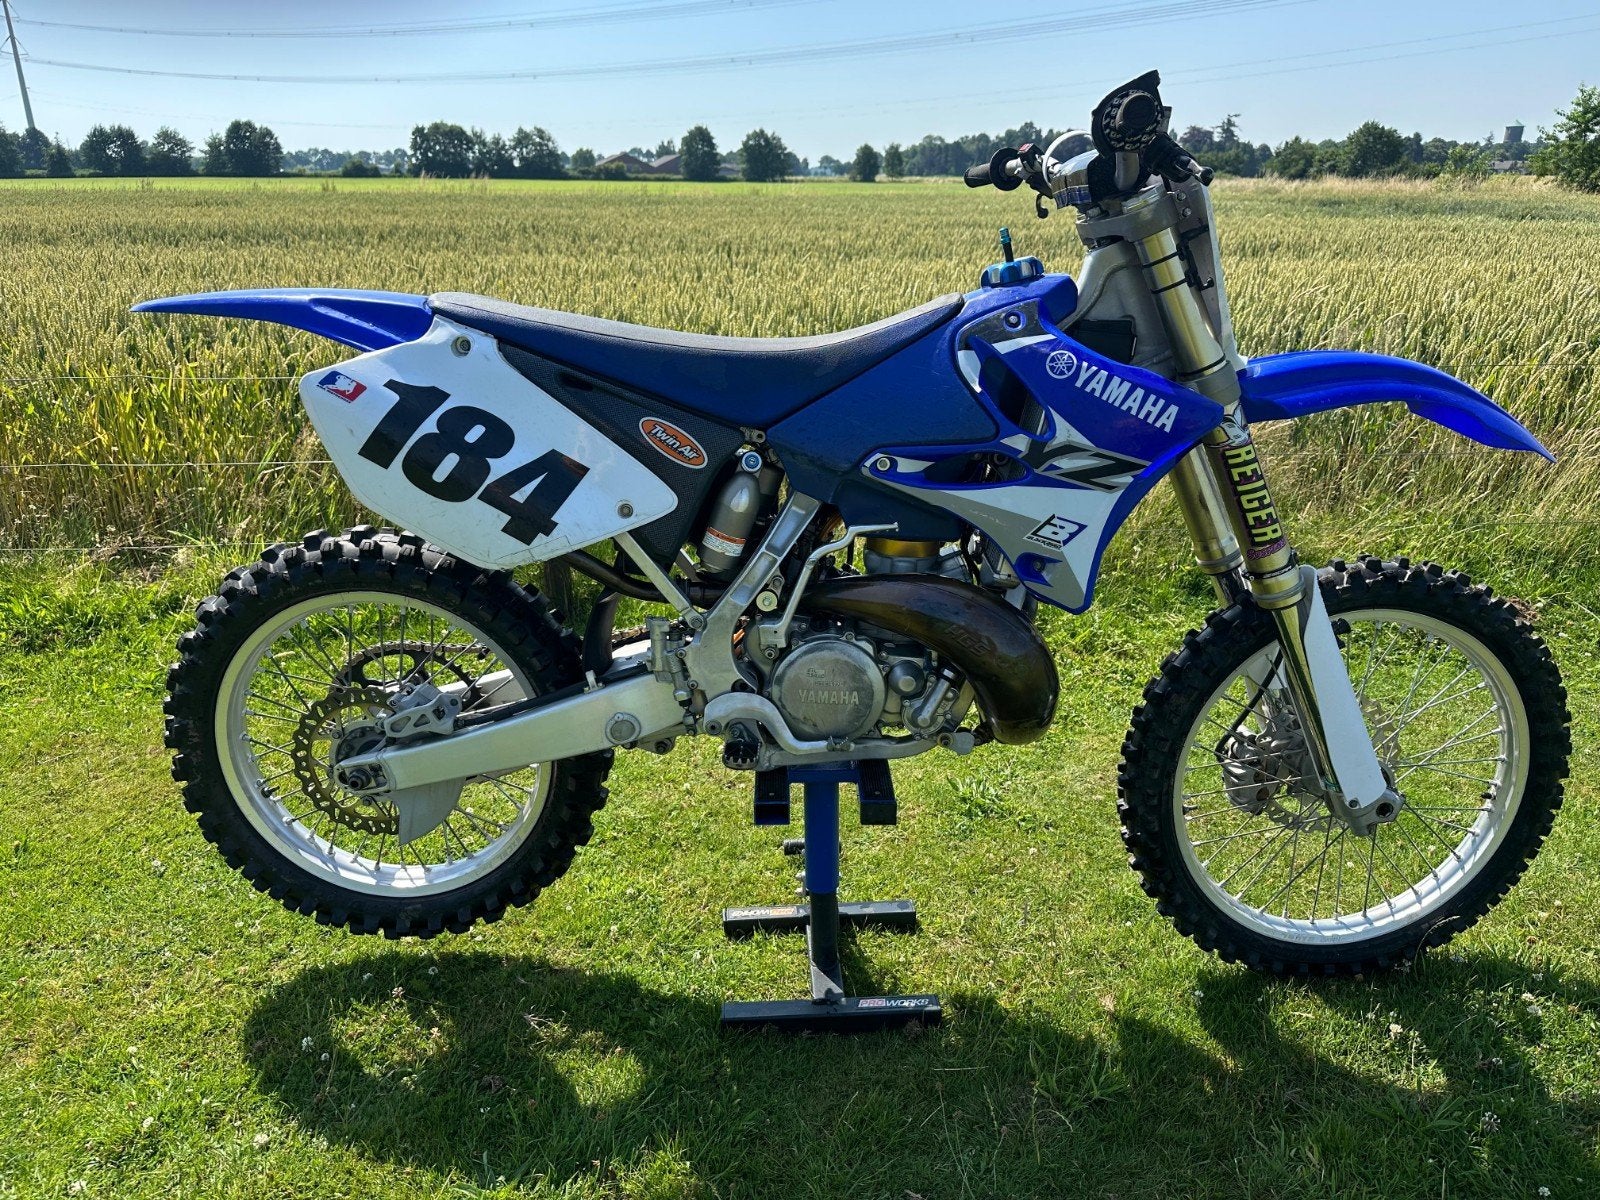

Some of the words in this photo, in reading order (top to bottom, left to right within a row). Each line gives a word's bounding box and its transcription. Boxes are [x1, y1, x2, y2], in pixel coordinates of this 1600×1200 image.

[1074, 361, 1180, 433] YAMAHA
[358, 379, 590, 546] 184
[649, 424, 680, 449] Twin
[677, 445, 700, 459] Air
[1019, 438, 1149, 492] YZ
[1225, 444, 1282, 542] REIGER
[798, 689, 860, 705] YAMAHA
